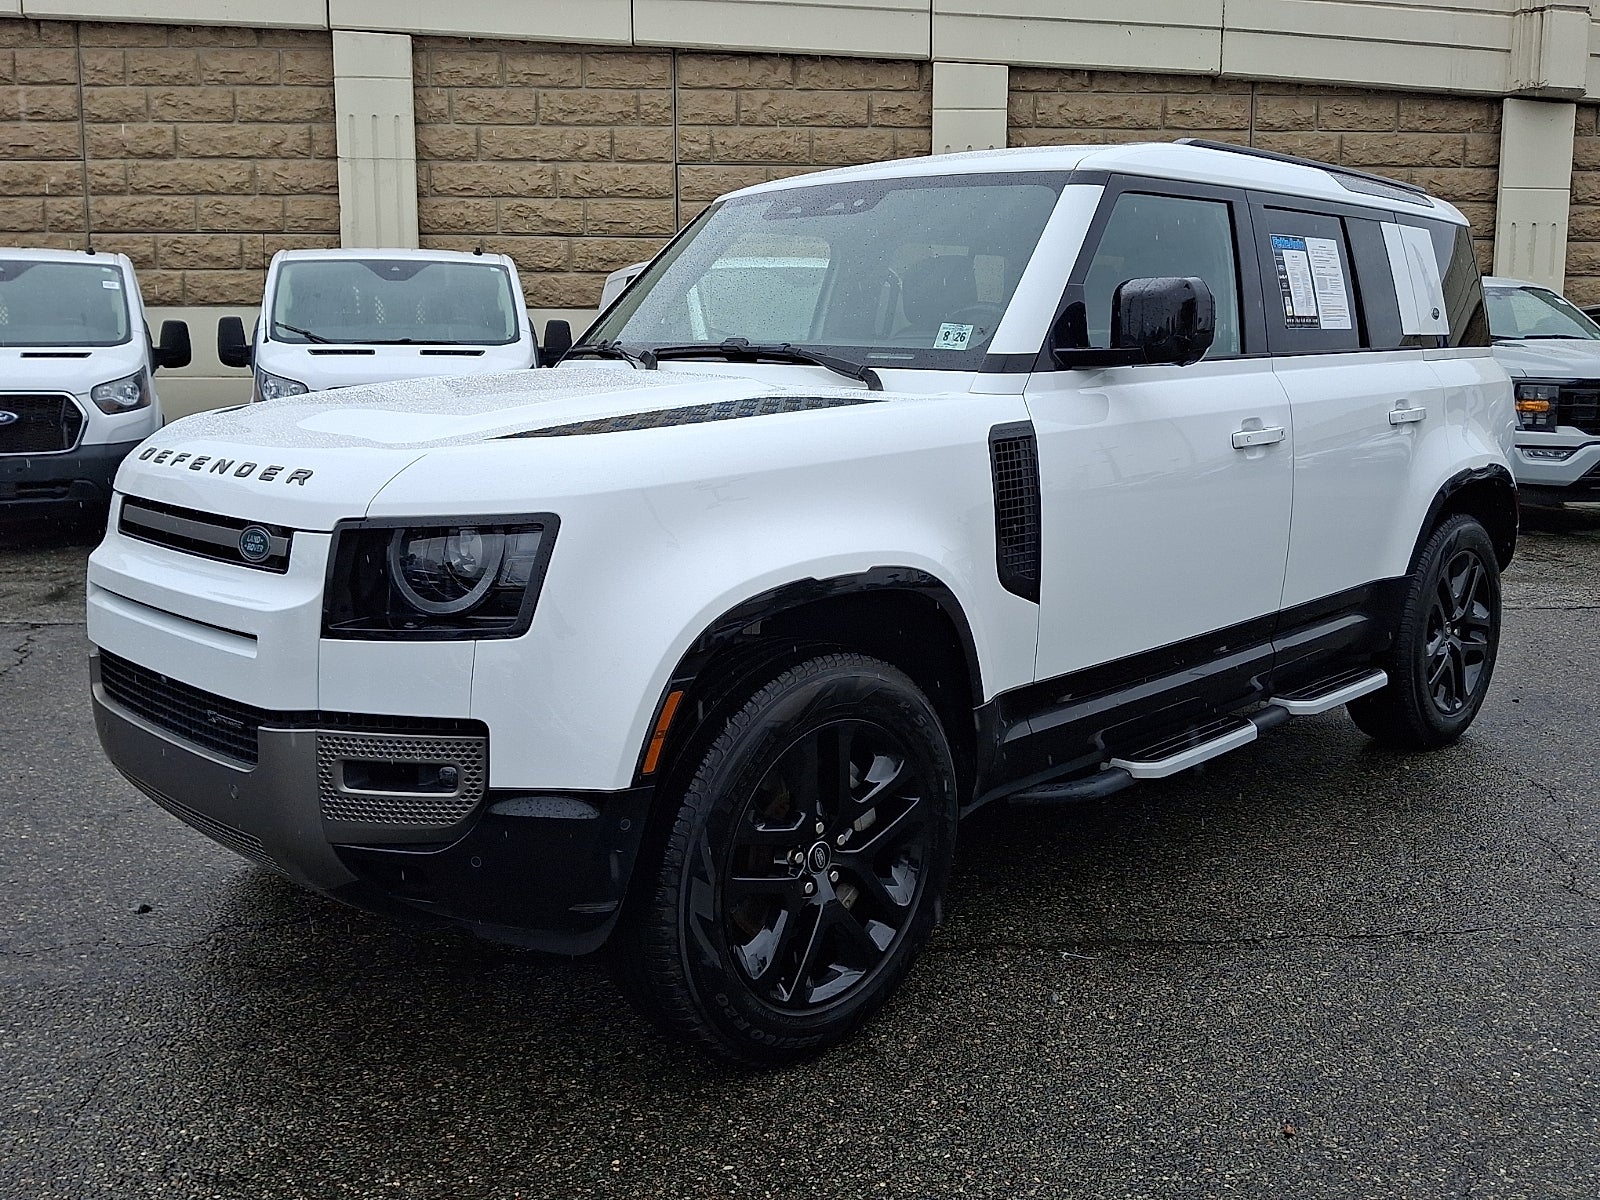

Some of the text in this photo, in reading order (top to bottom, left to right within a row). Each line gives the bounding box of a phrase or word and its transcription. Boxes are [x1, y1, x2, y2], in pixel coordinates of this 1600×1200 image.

[943, 331, 967, 342] 8 26
[138, 447, 314, 486] DEFENDER
[247, 535, 261, 543] LAND
[247, 543, 264, 552] ROVER
